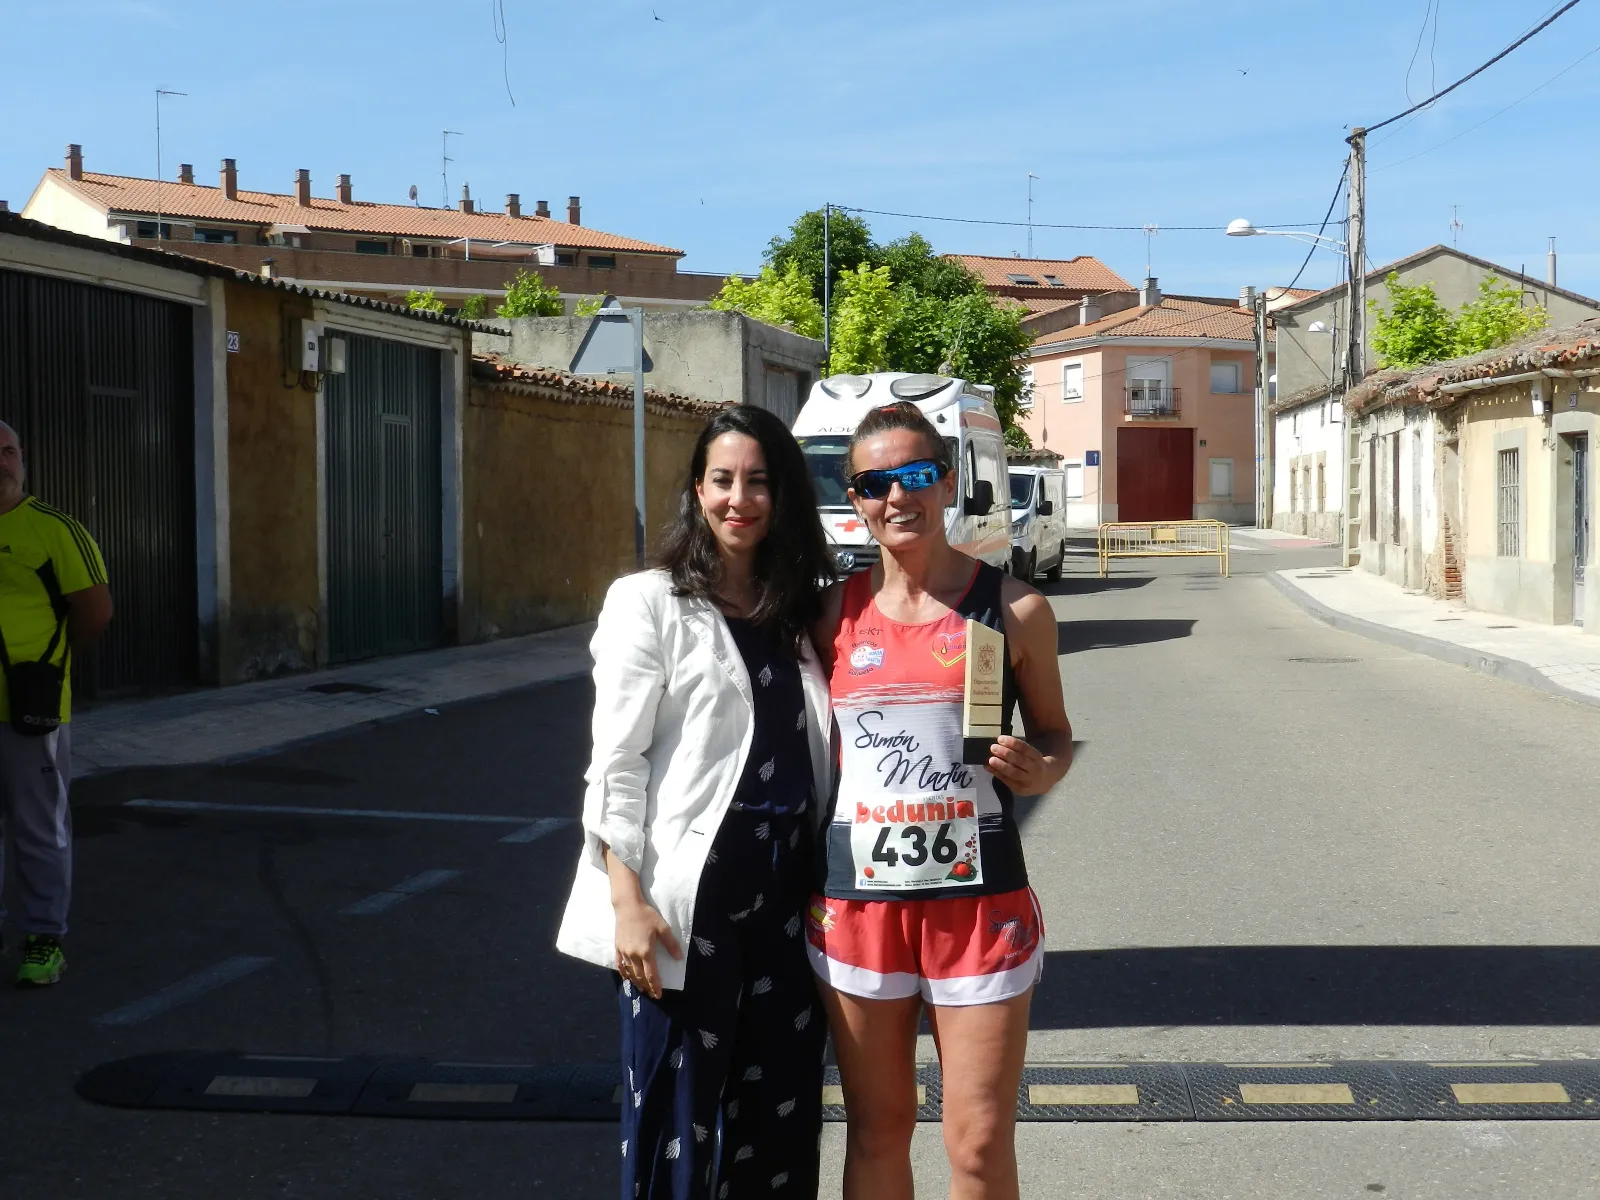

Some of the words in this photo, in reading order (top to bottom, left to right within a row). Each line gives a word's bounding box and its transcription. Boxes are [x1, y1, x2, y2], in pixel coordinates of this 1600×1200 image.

[228, 333, 239, 351] 23
[855, 710, 920, 752] Simón
[855, 797, 975, 824] bedunia
[871, 823, 958, 867] 436
